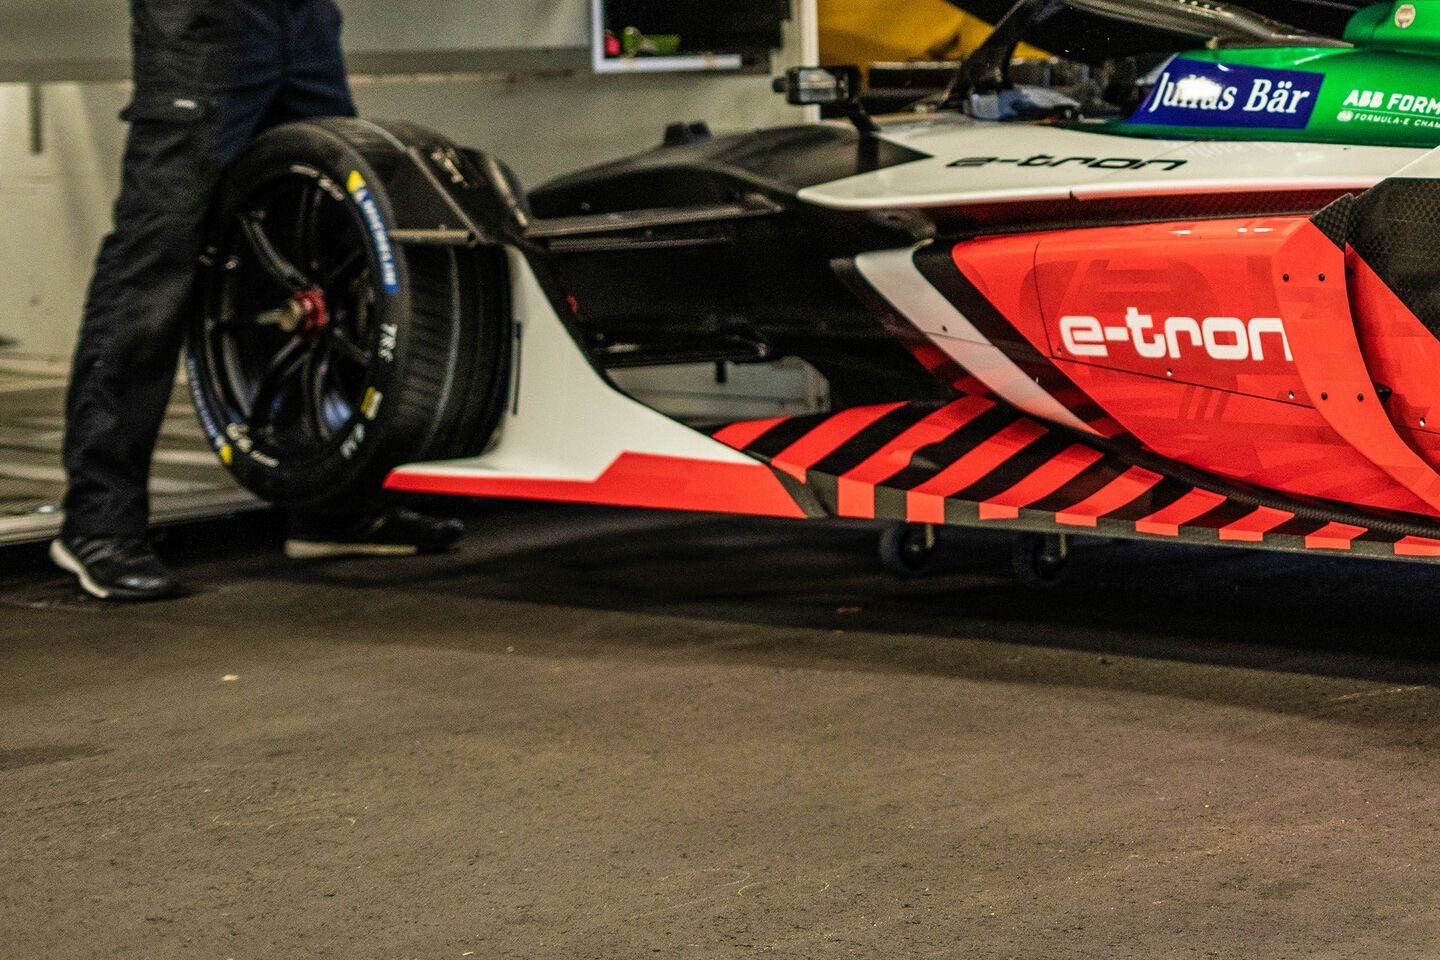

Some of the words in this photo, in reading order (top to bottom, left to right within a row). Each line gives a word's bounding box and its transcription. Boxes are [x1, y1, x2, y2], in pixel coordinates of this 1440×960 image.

[1243, 79, 1310, 113] Bär
[1343, 89, 1385, 108] ABB
[946, 154, 1188, 171] e-tron
[1059, 307, 1294, 361] e-tron
